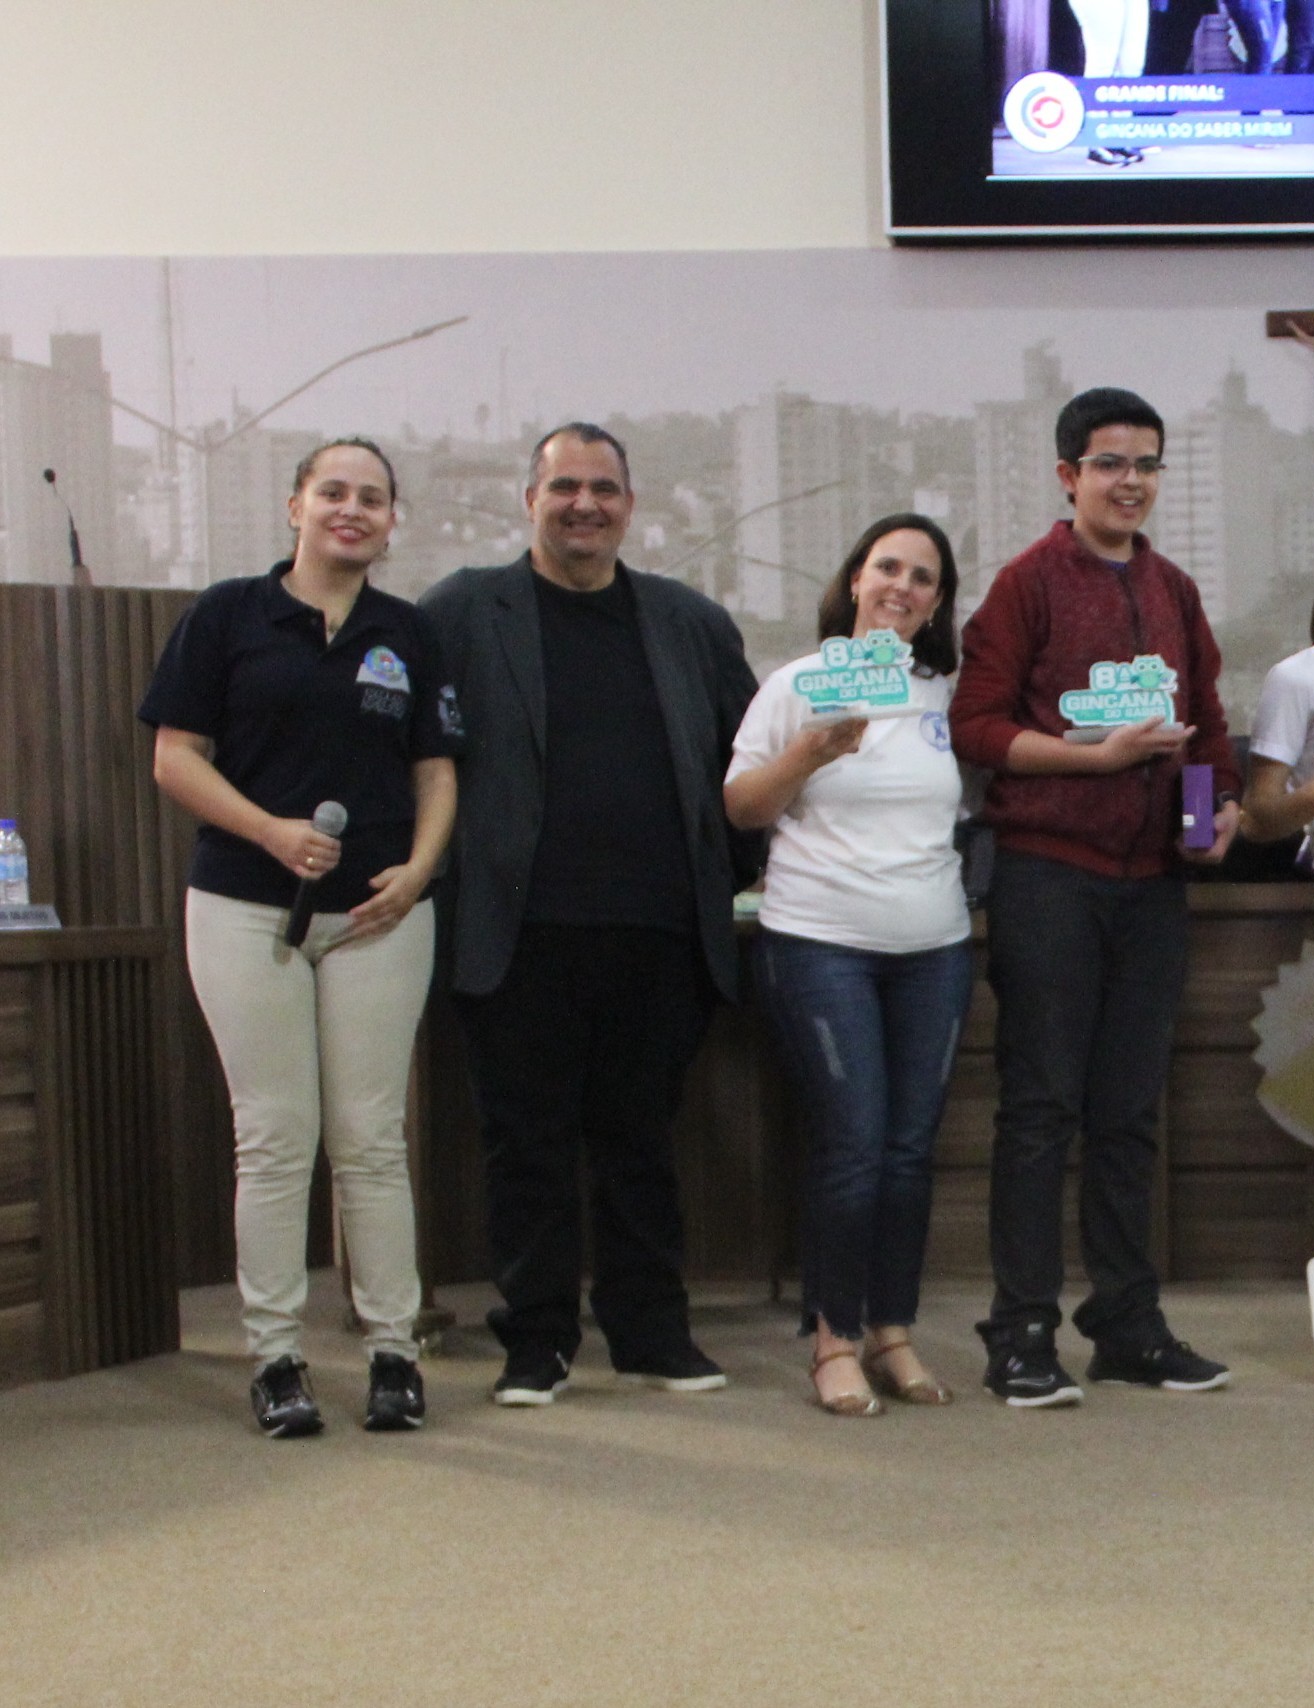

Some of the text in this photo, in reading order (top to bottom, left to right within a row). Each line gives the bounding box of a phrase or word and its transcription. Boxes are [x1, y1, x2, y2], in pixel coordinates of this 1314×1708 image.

[1095, 85, 1225, 102] GRANDE FINAL:
[1095, 122, 1166, 138] GINCANA
[1168, 122, 1193, 138] DO
[1195, 122, 1242, 137] SABER
[798, 667, 902, 692] GINCANA
[839, 682, 903, 698] DO SABER
[1065, 691, 1164, 711] GINCANA
[1104, 708, 1121, 719] DO
